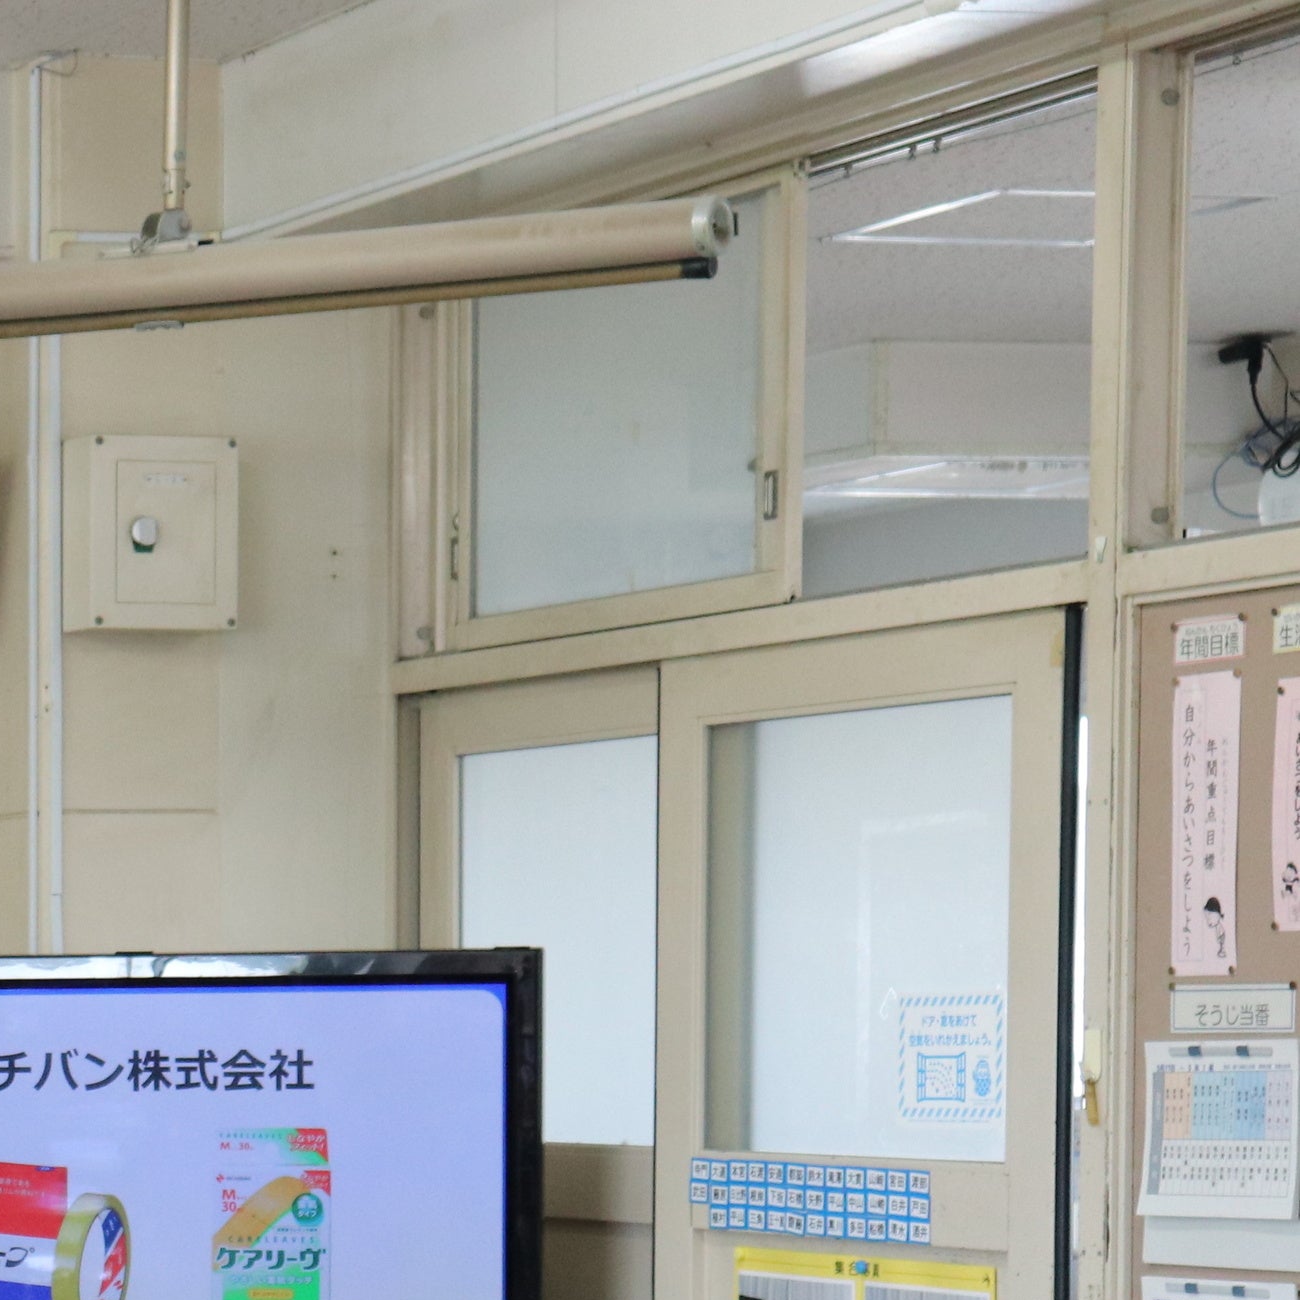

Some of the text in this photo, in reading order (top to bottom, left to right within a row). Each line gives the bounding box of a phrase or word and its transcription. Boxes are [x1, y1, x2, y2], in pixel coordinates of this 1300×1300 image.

[1181, 632, 1239, 659] 年間目標
[1204, 738, 1218, 870] 年間重点目標
[1182, 705, 1195, 956] 自分からあいさつをしよう
[1194, 1003, 1270, 1026] そうじ当番
[216, 1247, 326, 1270] ケアリーヴ
